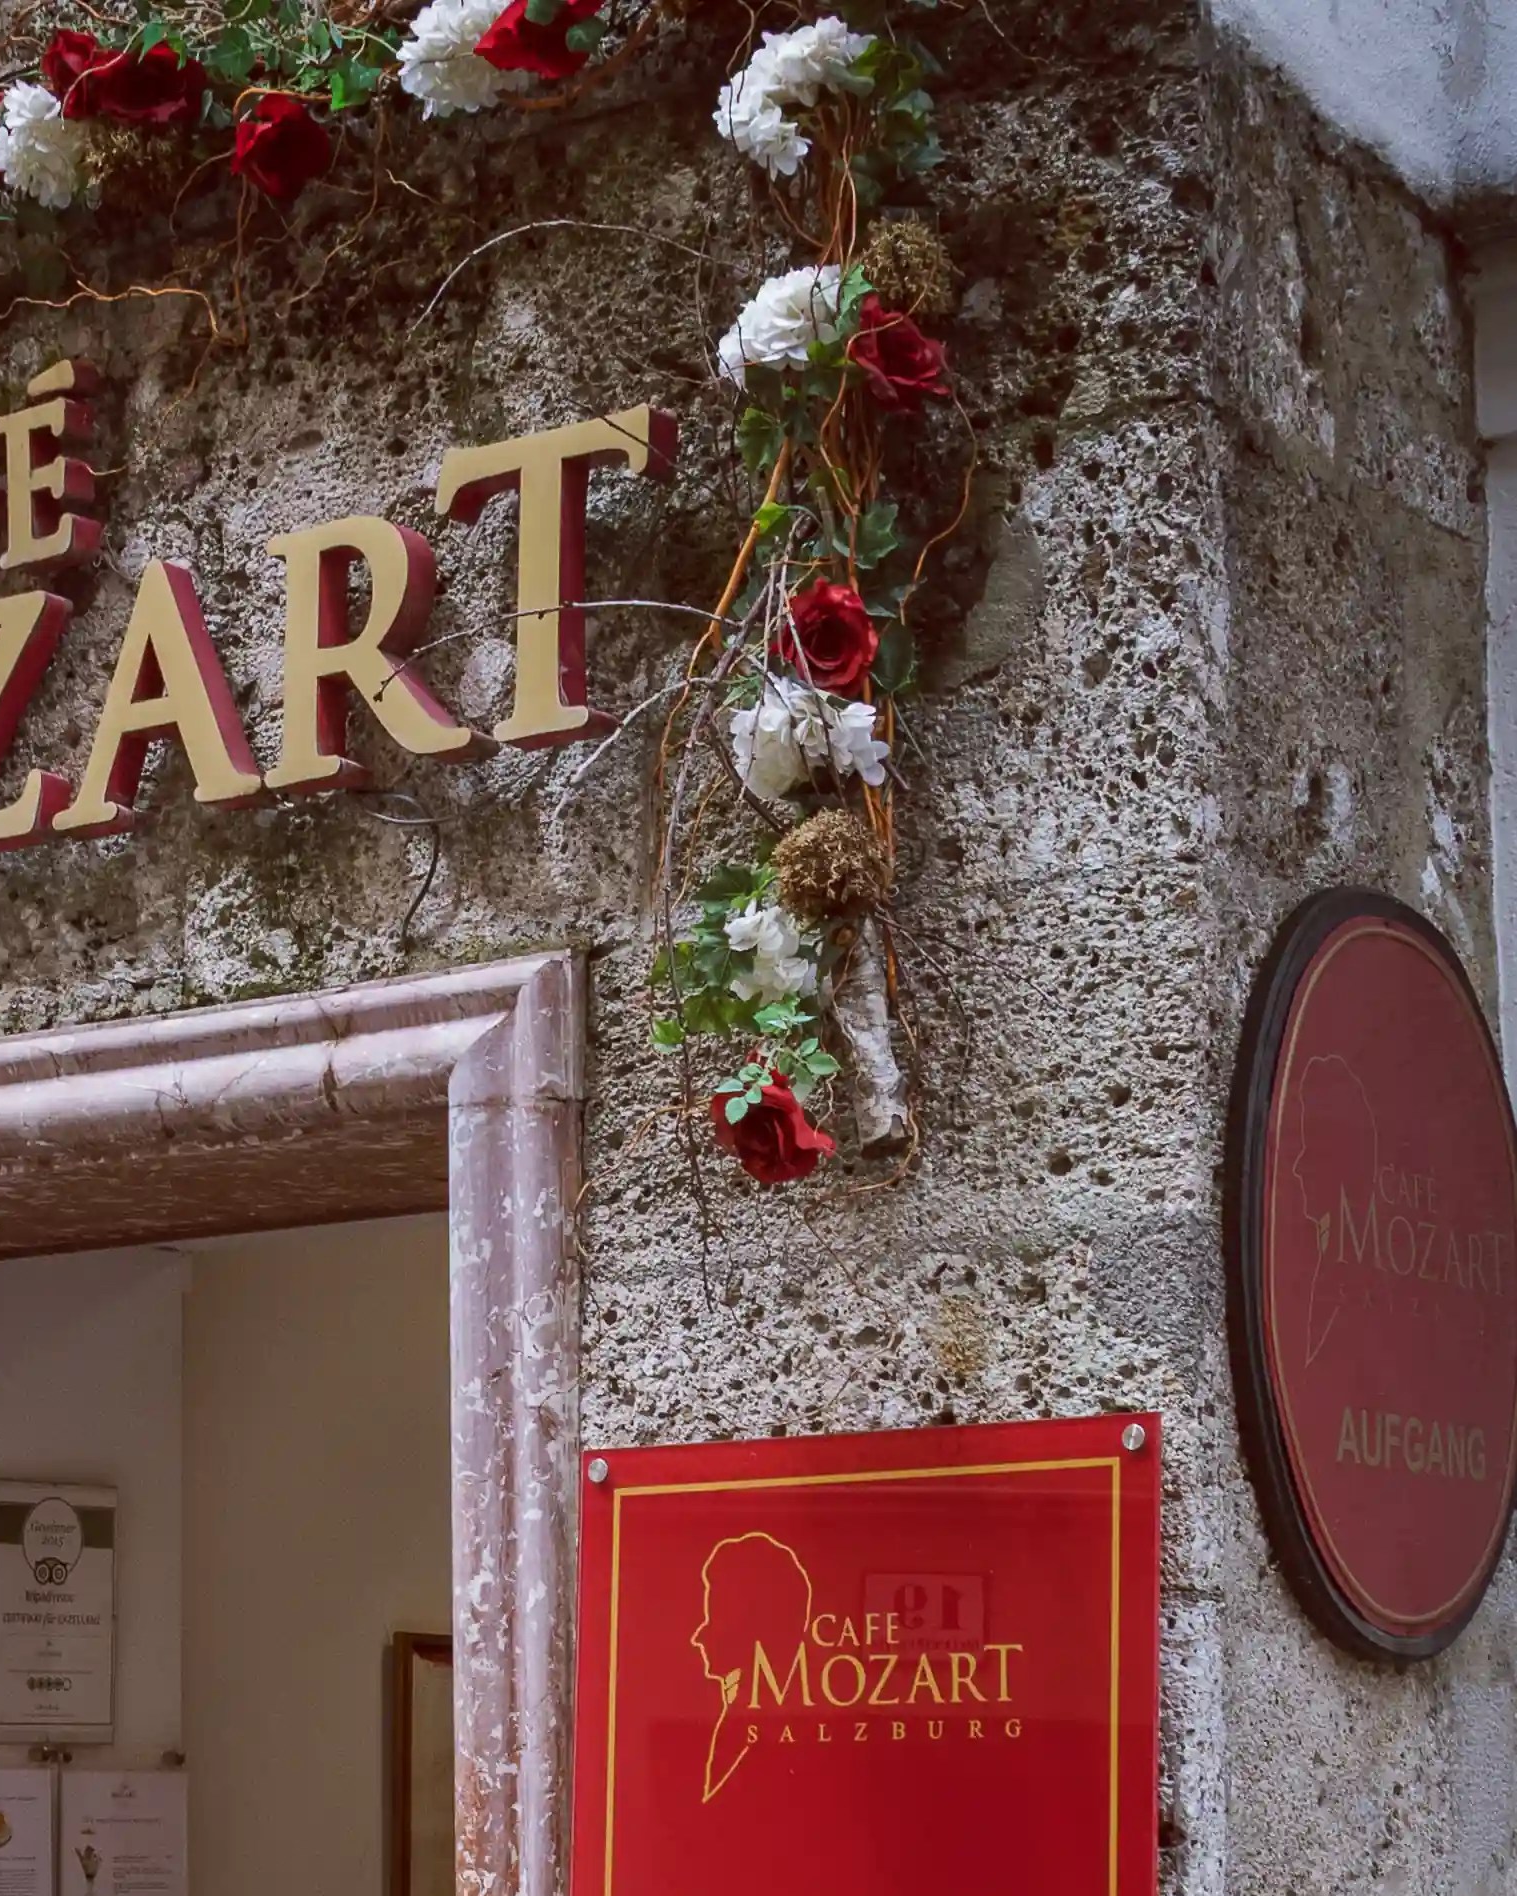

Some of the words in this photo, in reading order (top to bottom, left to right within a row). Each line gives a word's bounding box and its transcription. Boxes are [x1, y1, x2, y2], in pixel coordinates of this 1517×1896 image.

[1336, 1180, 1508, 1297] MOZART
[1335, 1405, 1486, 1481] AUFGANG
[810, 1612, 900, 1648] CAFE
[747, 1640, 1024, 1708] MOZART
[746, 1719, 1023, 1744] SALZBURG
